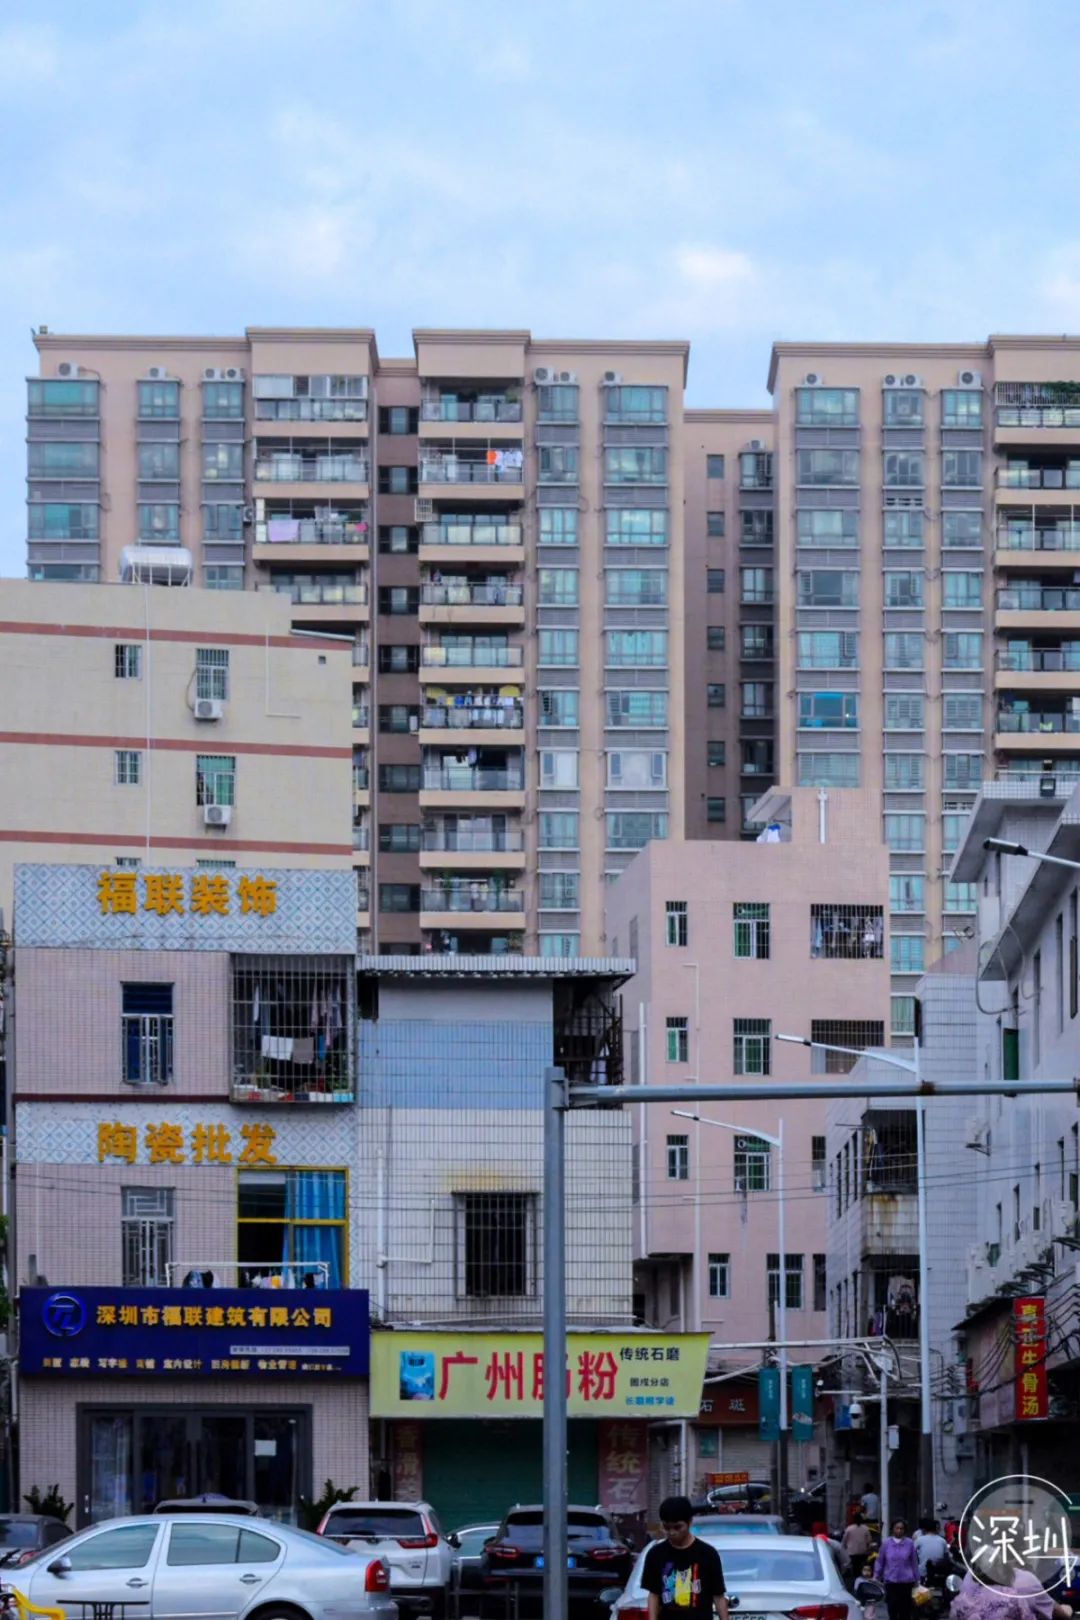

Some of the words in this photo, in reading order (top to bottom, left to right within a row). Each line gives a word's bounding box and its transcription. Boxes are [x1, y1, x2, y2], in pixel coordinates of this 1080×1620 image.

[97, 872, 278, 917] 福联装饰
[97, 1121, 278, 1164] 陶瓷批发
[97, 1305, 332, 1327] 深圳市福联建筑有限公司
[620, 1347, 680, 1361] 传统石磨
